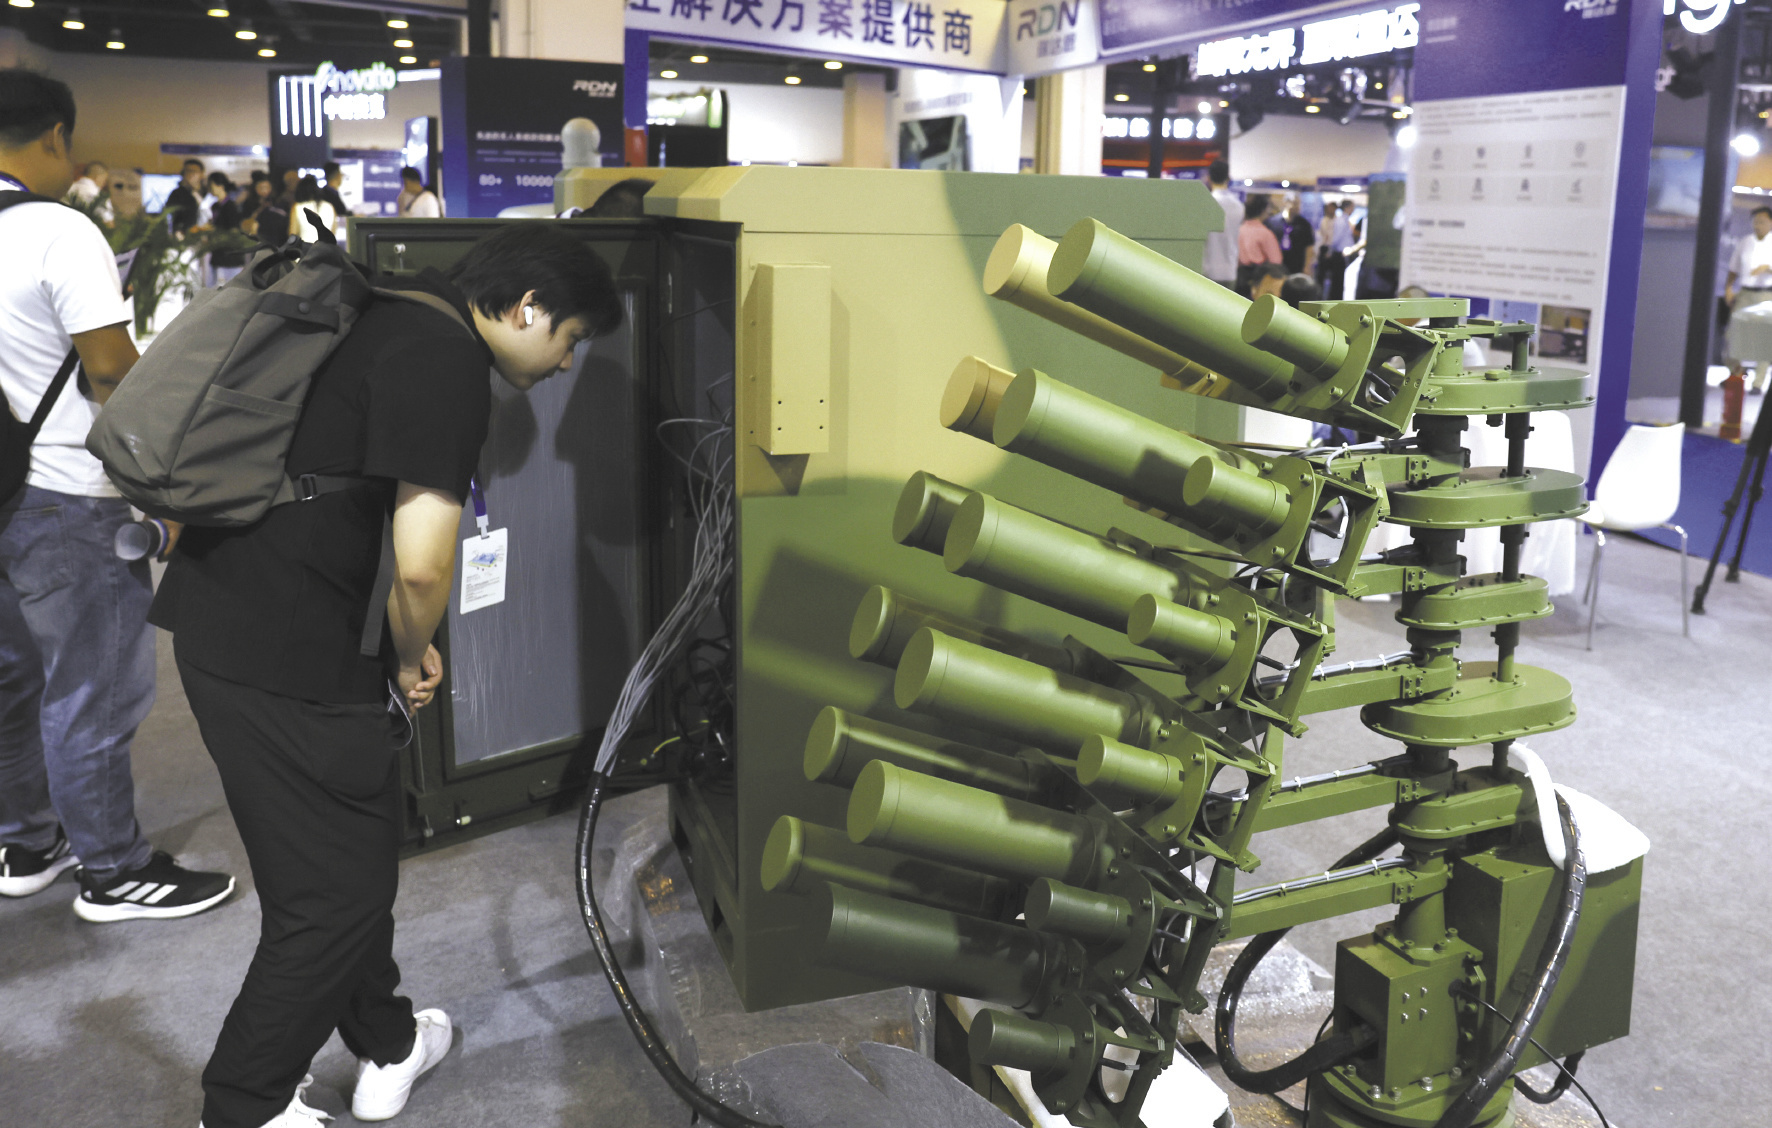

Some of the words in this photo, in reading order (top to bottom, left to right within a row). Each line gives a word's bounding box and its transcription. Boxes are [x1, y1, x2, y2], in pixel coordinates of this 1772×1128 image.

[630, 0, 973, 55] 决方案提供商
[1017, 0, 1079, 41] RDN
[572, 80, 617, 93] RDN
